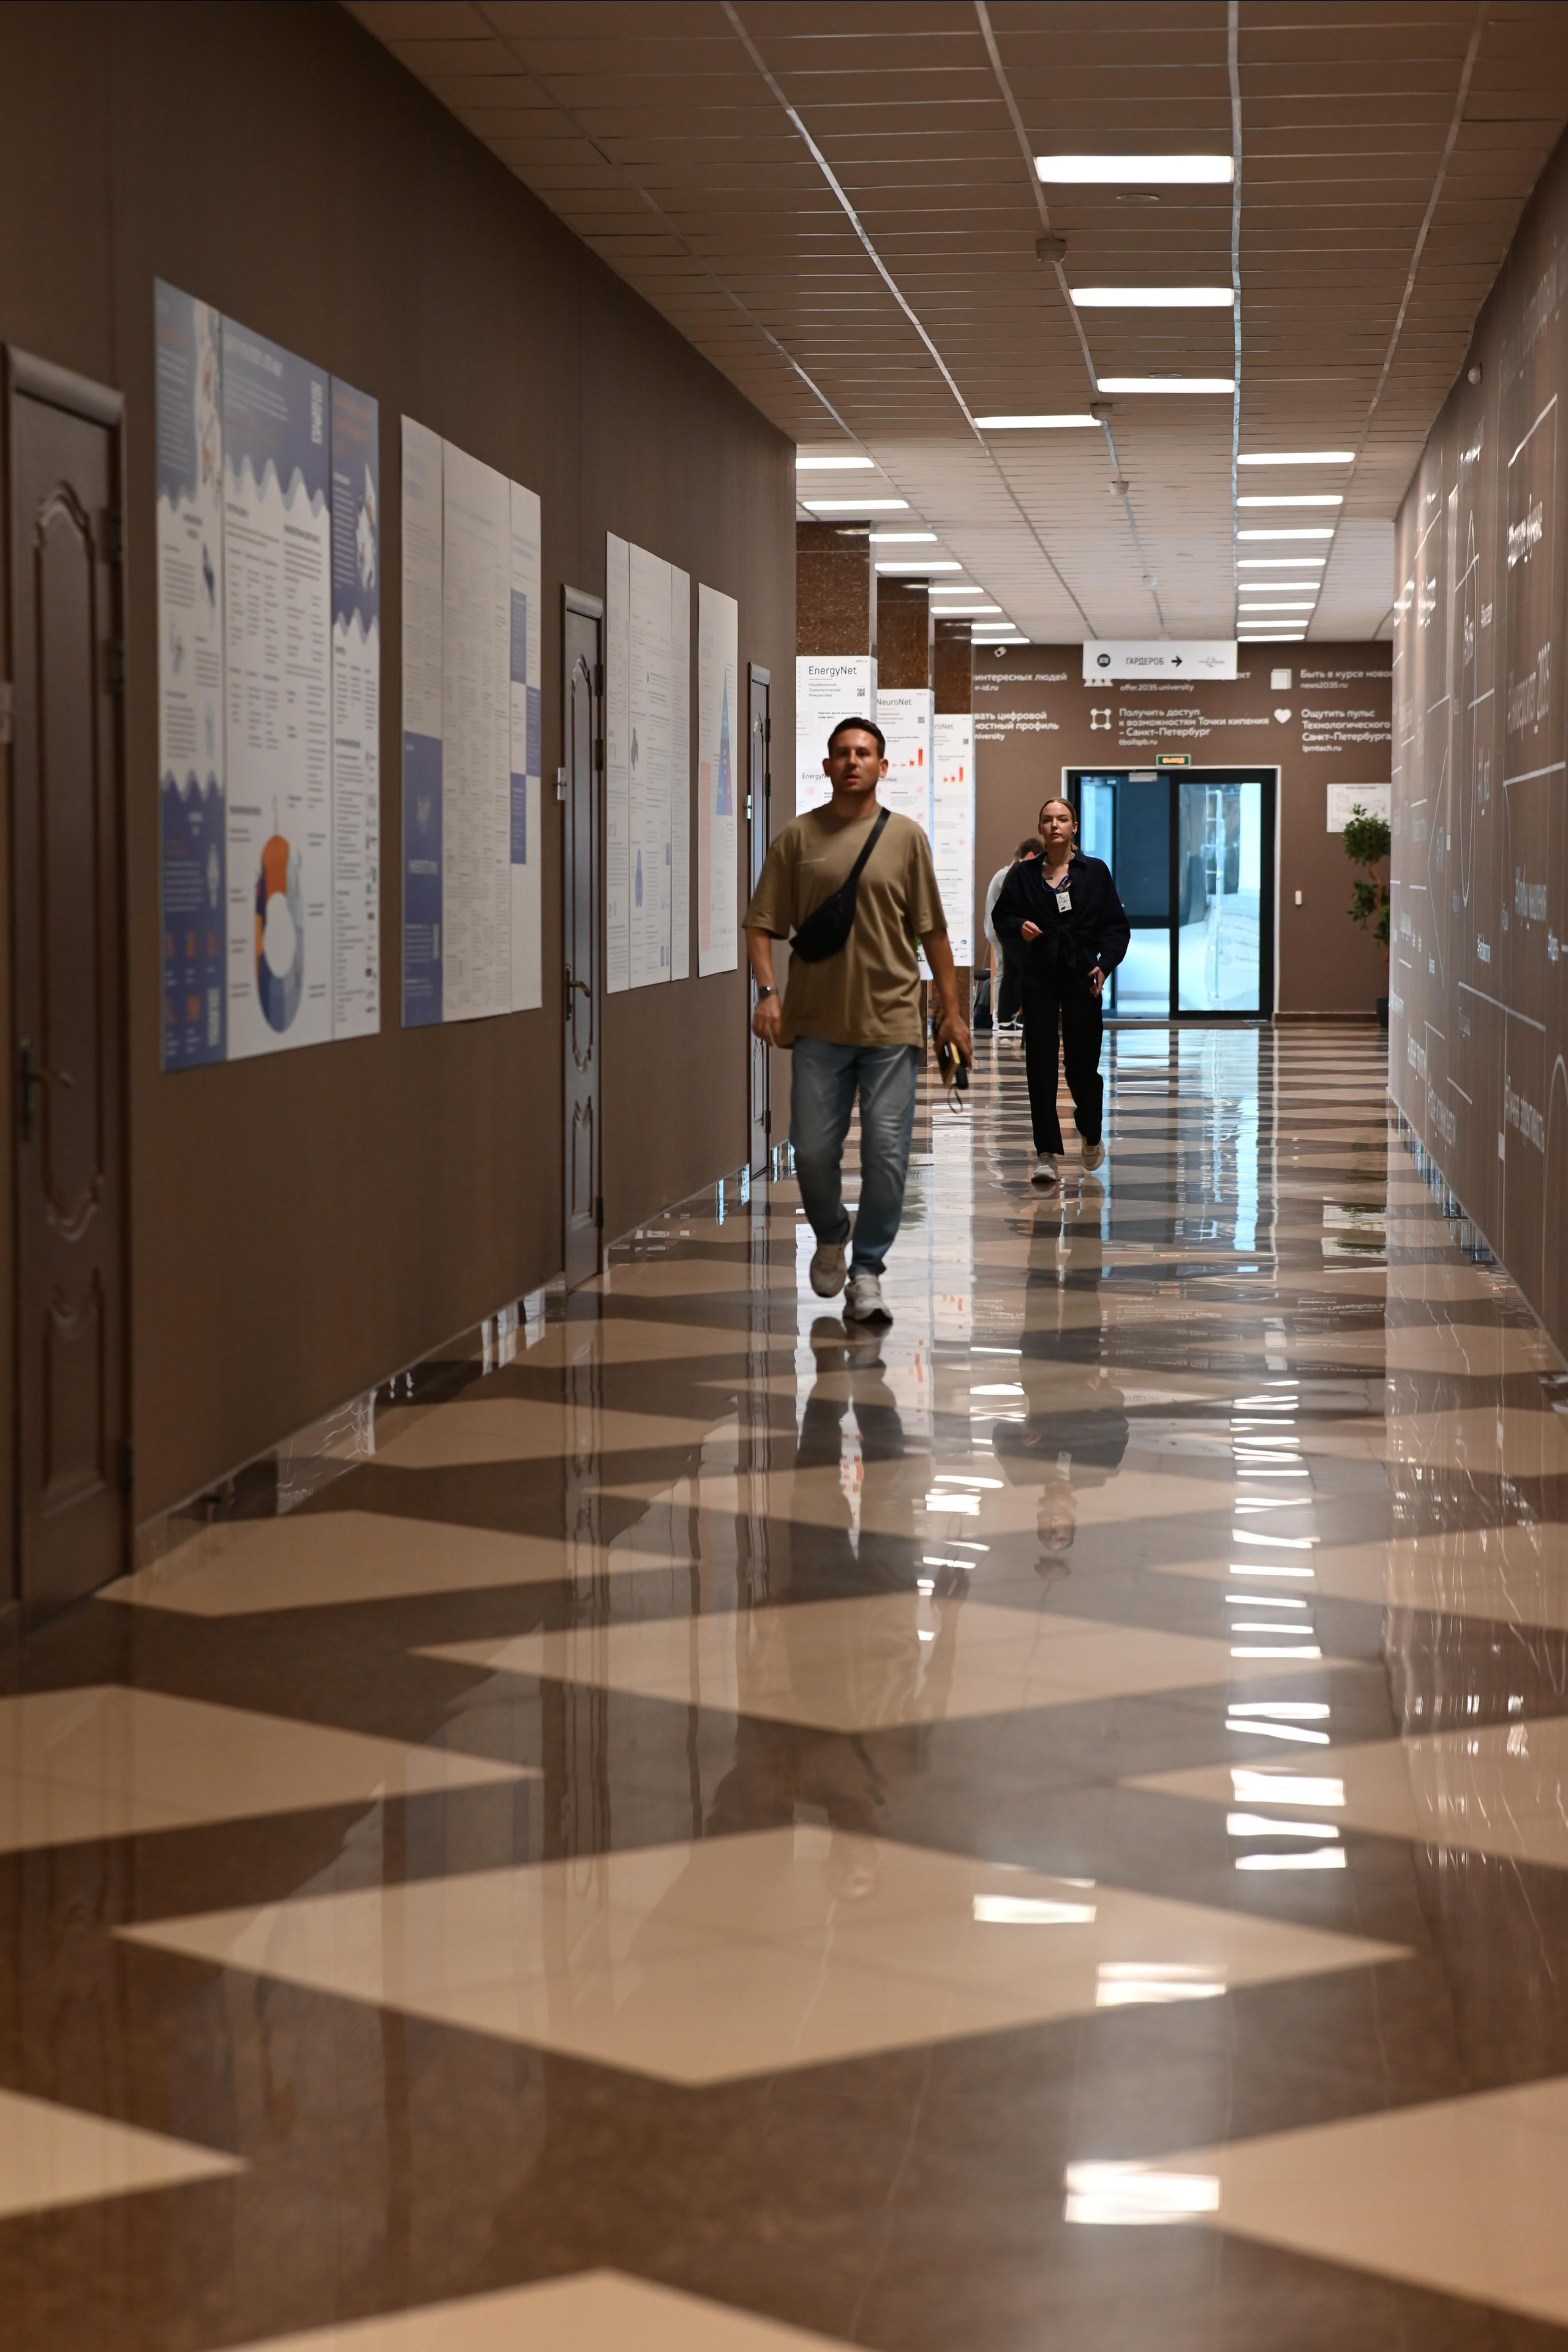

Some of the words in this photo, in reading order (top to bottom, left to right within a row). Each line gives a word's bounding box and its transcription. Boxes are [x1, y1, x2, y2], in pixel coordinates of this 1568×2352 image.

[1125, 657, 1164, 666] ГАРДЕРОБ
[809, 666, 857, 677] EnergyNet
[1300, 669, 1325, 678] Быть
[1335, 671, 1363, 680] курсе
[1034, 673, 1068, 682] людей
[1120, 684, 1194, 693] offer.2035.university
[997, 711, 1047, 722] цифровой
[1118, 709, 1164, 718] Получить
[1166, 709, 1200, 718] доступ
[1301, 709, 1345, 720] Ощутить
[1347, 710, 1376, 719] пульс
[1016, 721, 1060, 731] профиль
[1126, 718, 1196, 727] возможностям
[1198, 717, 1226, 726] Точки
[1302, 720, 1391, 729] Технологического
[1126, 727, 1212, 737] Санкт-Петербург
[1302, 732, 1392, 743] Санкт-Петербурга
